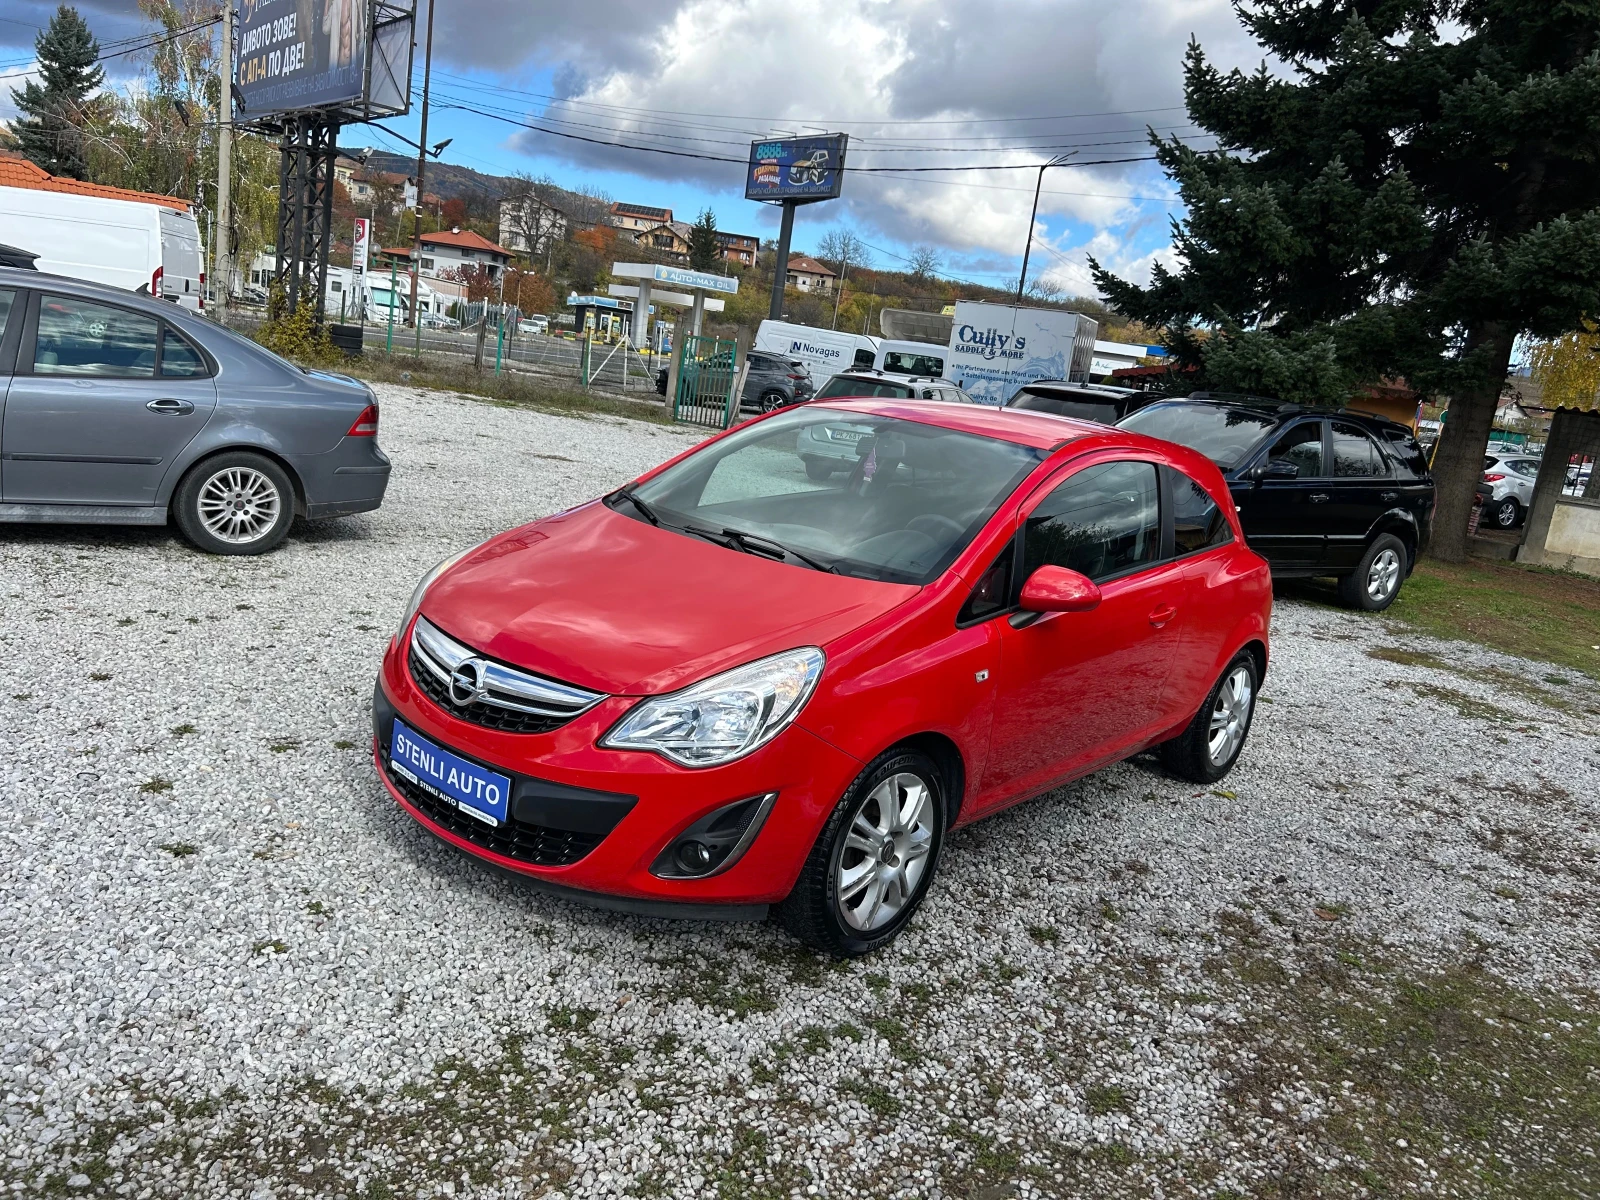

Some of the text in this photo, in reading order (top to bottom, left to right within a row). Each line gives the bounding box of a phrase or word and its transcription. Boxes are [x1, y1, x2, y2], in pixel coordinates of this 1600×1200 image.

[241, 12, 297, 57] ДИВОТО ЗОВЕ!
[240, 61, 246, 86] С
[268, 50, 281, 78] ПО
[281, 41, 305, 77] ДВЕ!
[717, 281, 730, 290] OIL
[958, 325, 1025, 350] Cully's
[803, 343, 840, 358] Novagas
[955, 344, 1025, 359] SADDLE & MORE
[396, 733, 444, 780] STENLI
[446, 767, 500, 805] AUTO
[419, 780, 457, 806] STENLI AUTO
